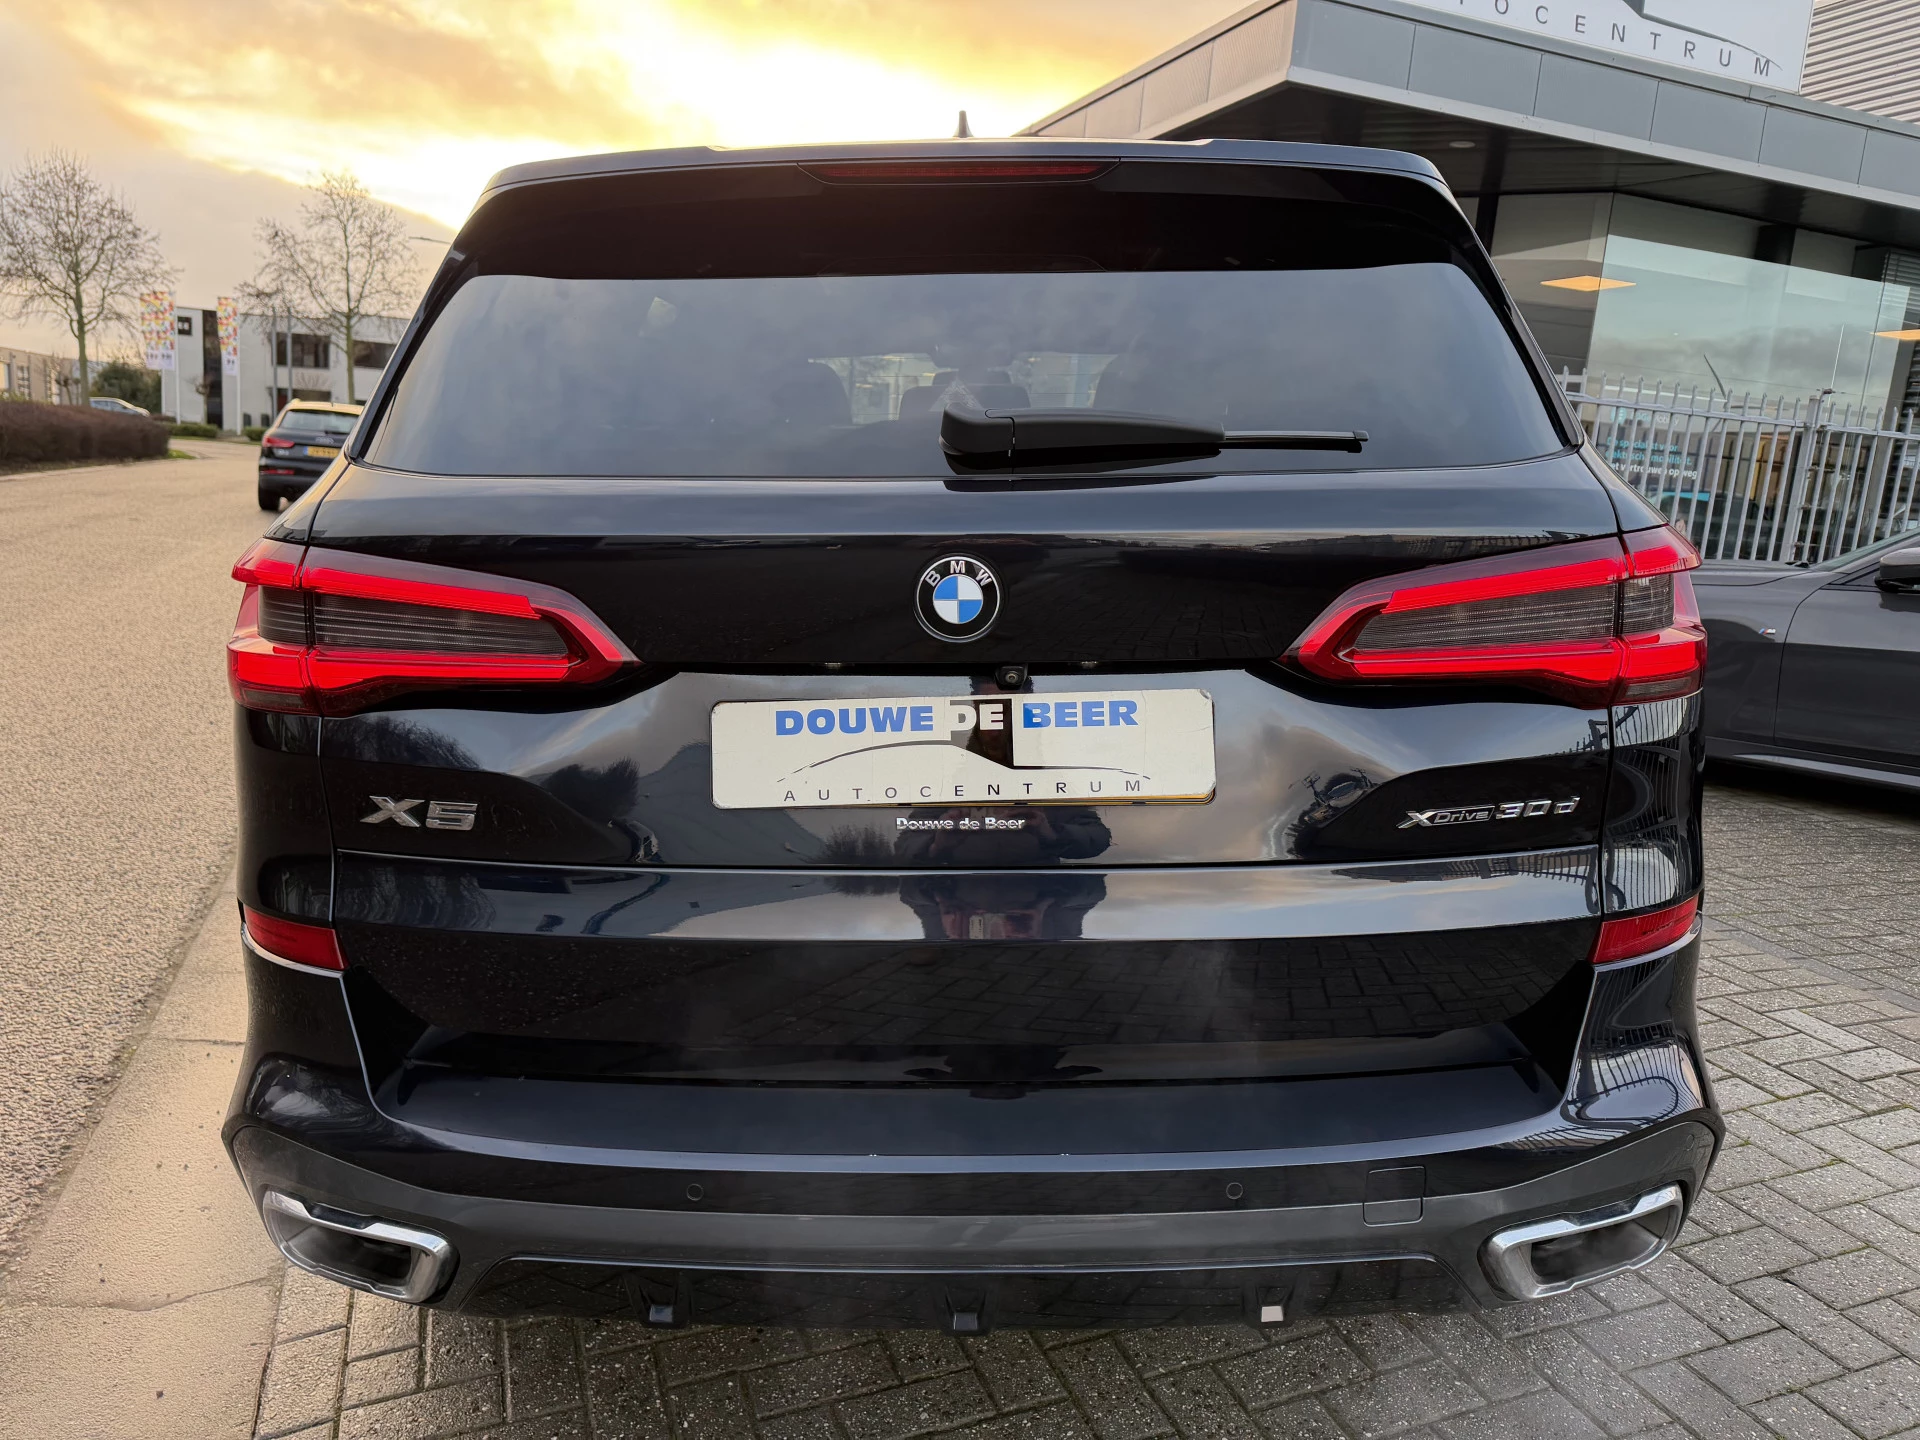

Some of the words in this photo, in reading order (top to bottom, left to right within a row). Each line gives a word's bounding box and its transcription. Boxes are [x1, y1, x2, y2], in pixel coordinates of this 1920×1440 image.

[1459, 0, 1770, 78] OCENTRUM
[1659, 443, 1678, 452] vor
[1668, 468, 1680, 478] op
[925, 560, 993, 588] BMW
[775, 705, 935, 736] DOUWE
[950, 703, 1004, 732] DE
[1023, 700, 1139, 729] BEER
[783, 780, 1142, 802] AUTOCENTRUM
[360, 795, 478, 831] X5
[896, 817, 954, 830] Douwe
[959, 817, 980, 830] de
[984, 817, 1025, 830] Beer
